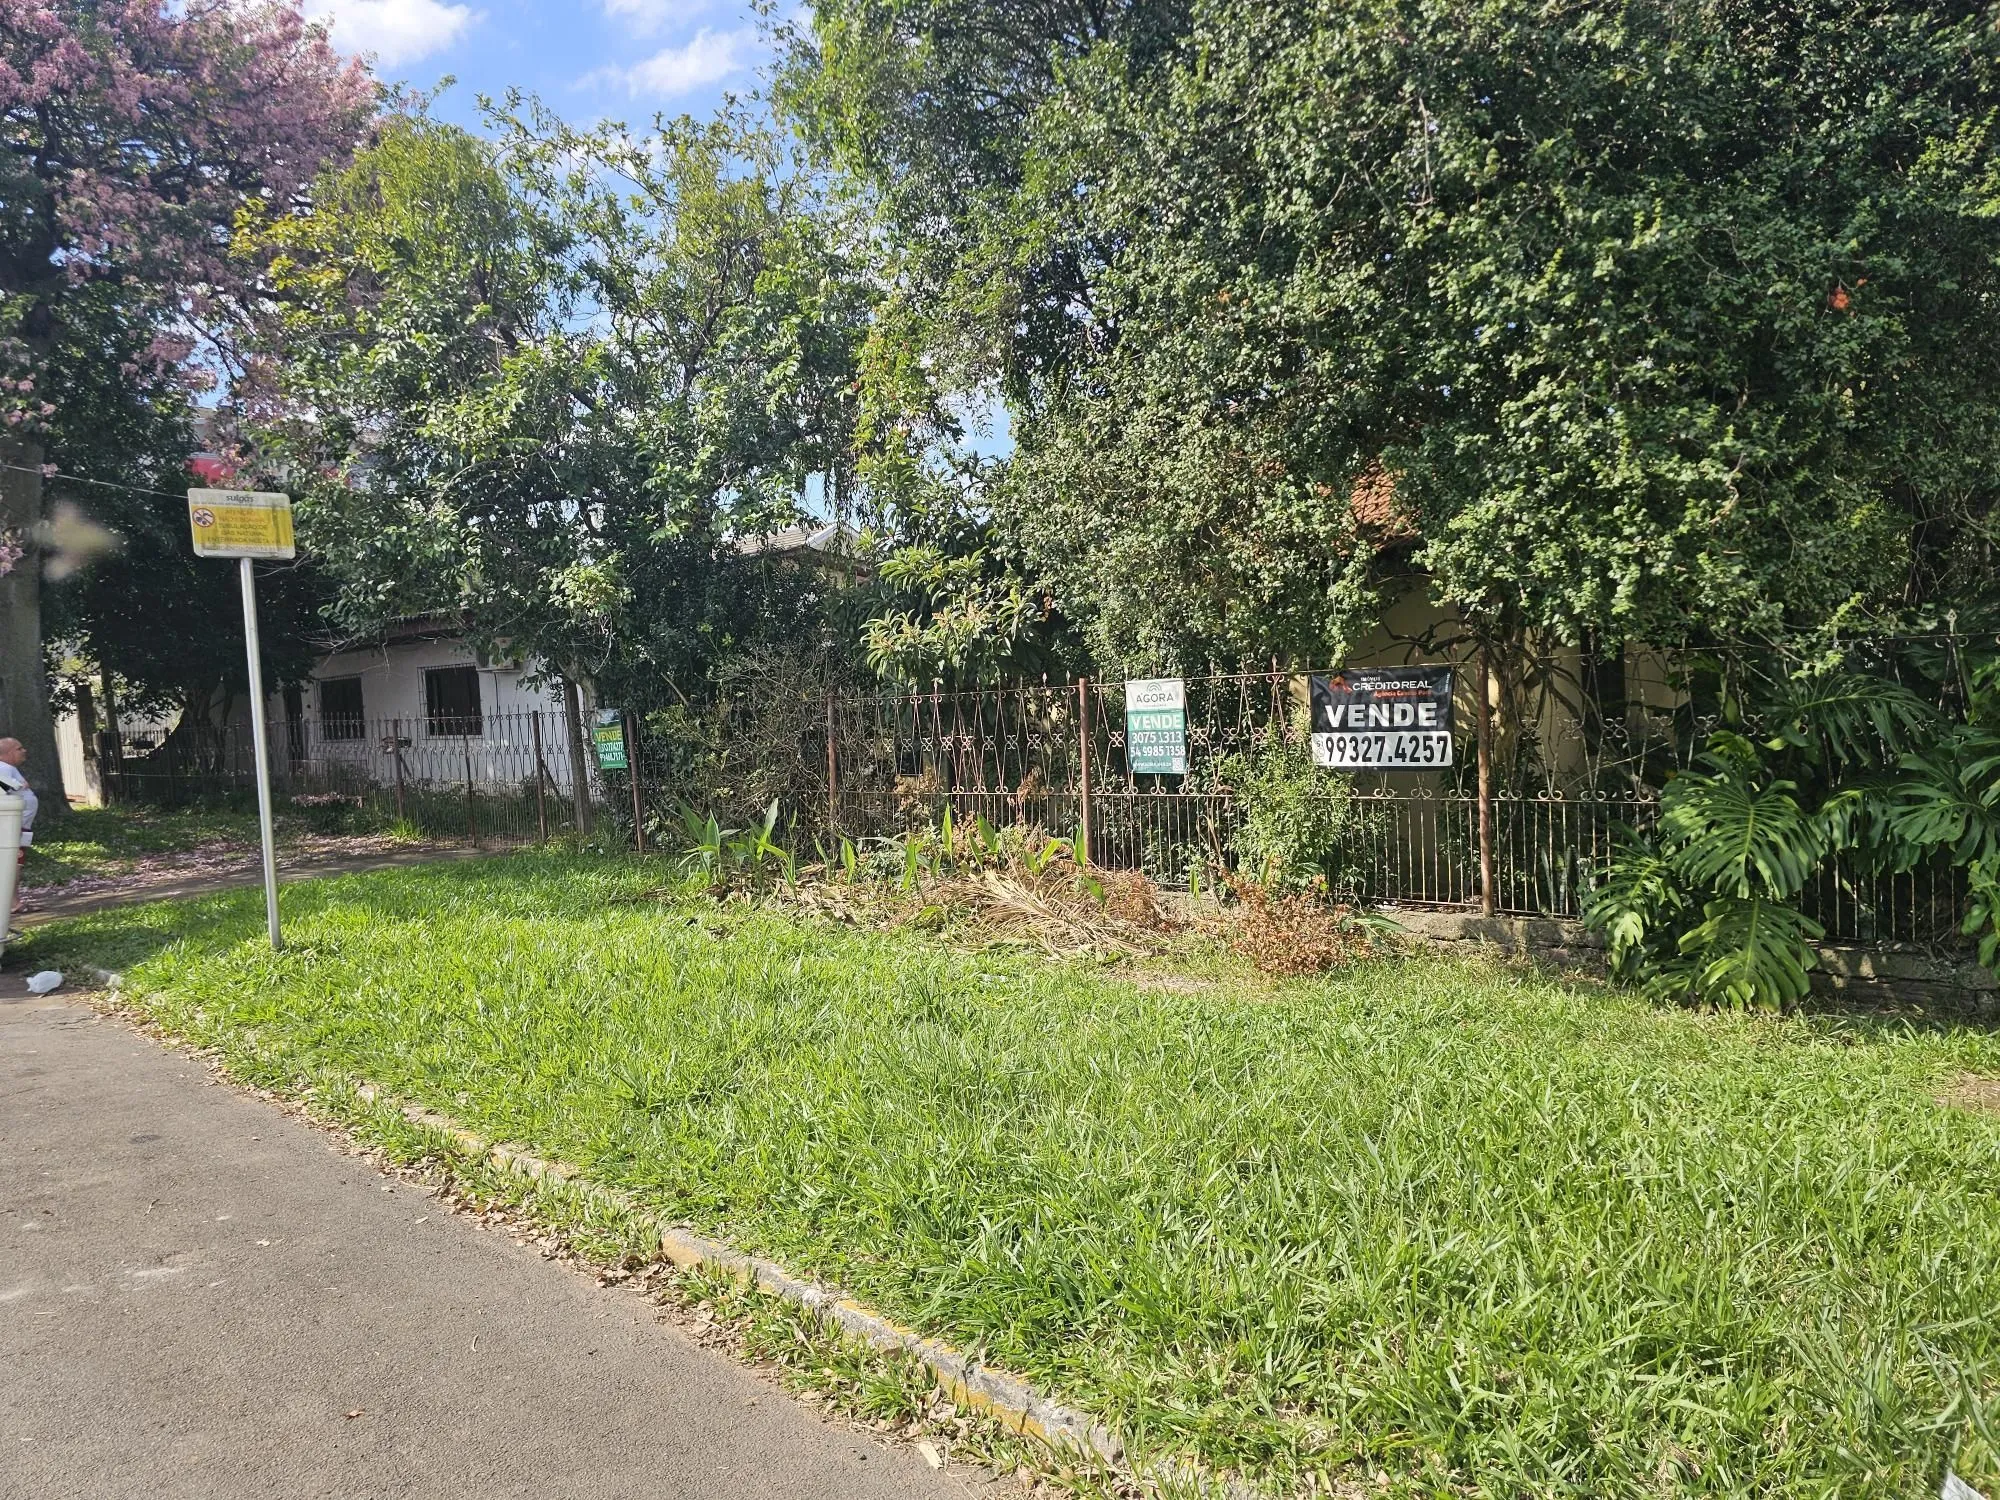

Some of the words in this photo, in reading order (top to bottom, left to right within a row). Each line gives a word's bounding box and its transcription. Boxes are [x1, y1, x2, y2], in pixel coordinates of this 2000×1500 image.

[1401, 680, 1433, 689] REAL
[1131, 713, 1182, 730] VENDE
[1325, 702, 1438, 728] VENDE
[595, 730, 622, 742] VENDE
[1132, 731, 1156, 744] 3075
[1158, 731, 1182, 743] 1313
[1325, 735, 1448, 763] 99327.4257
